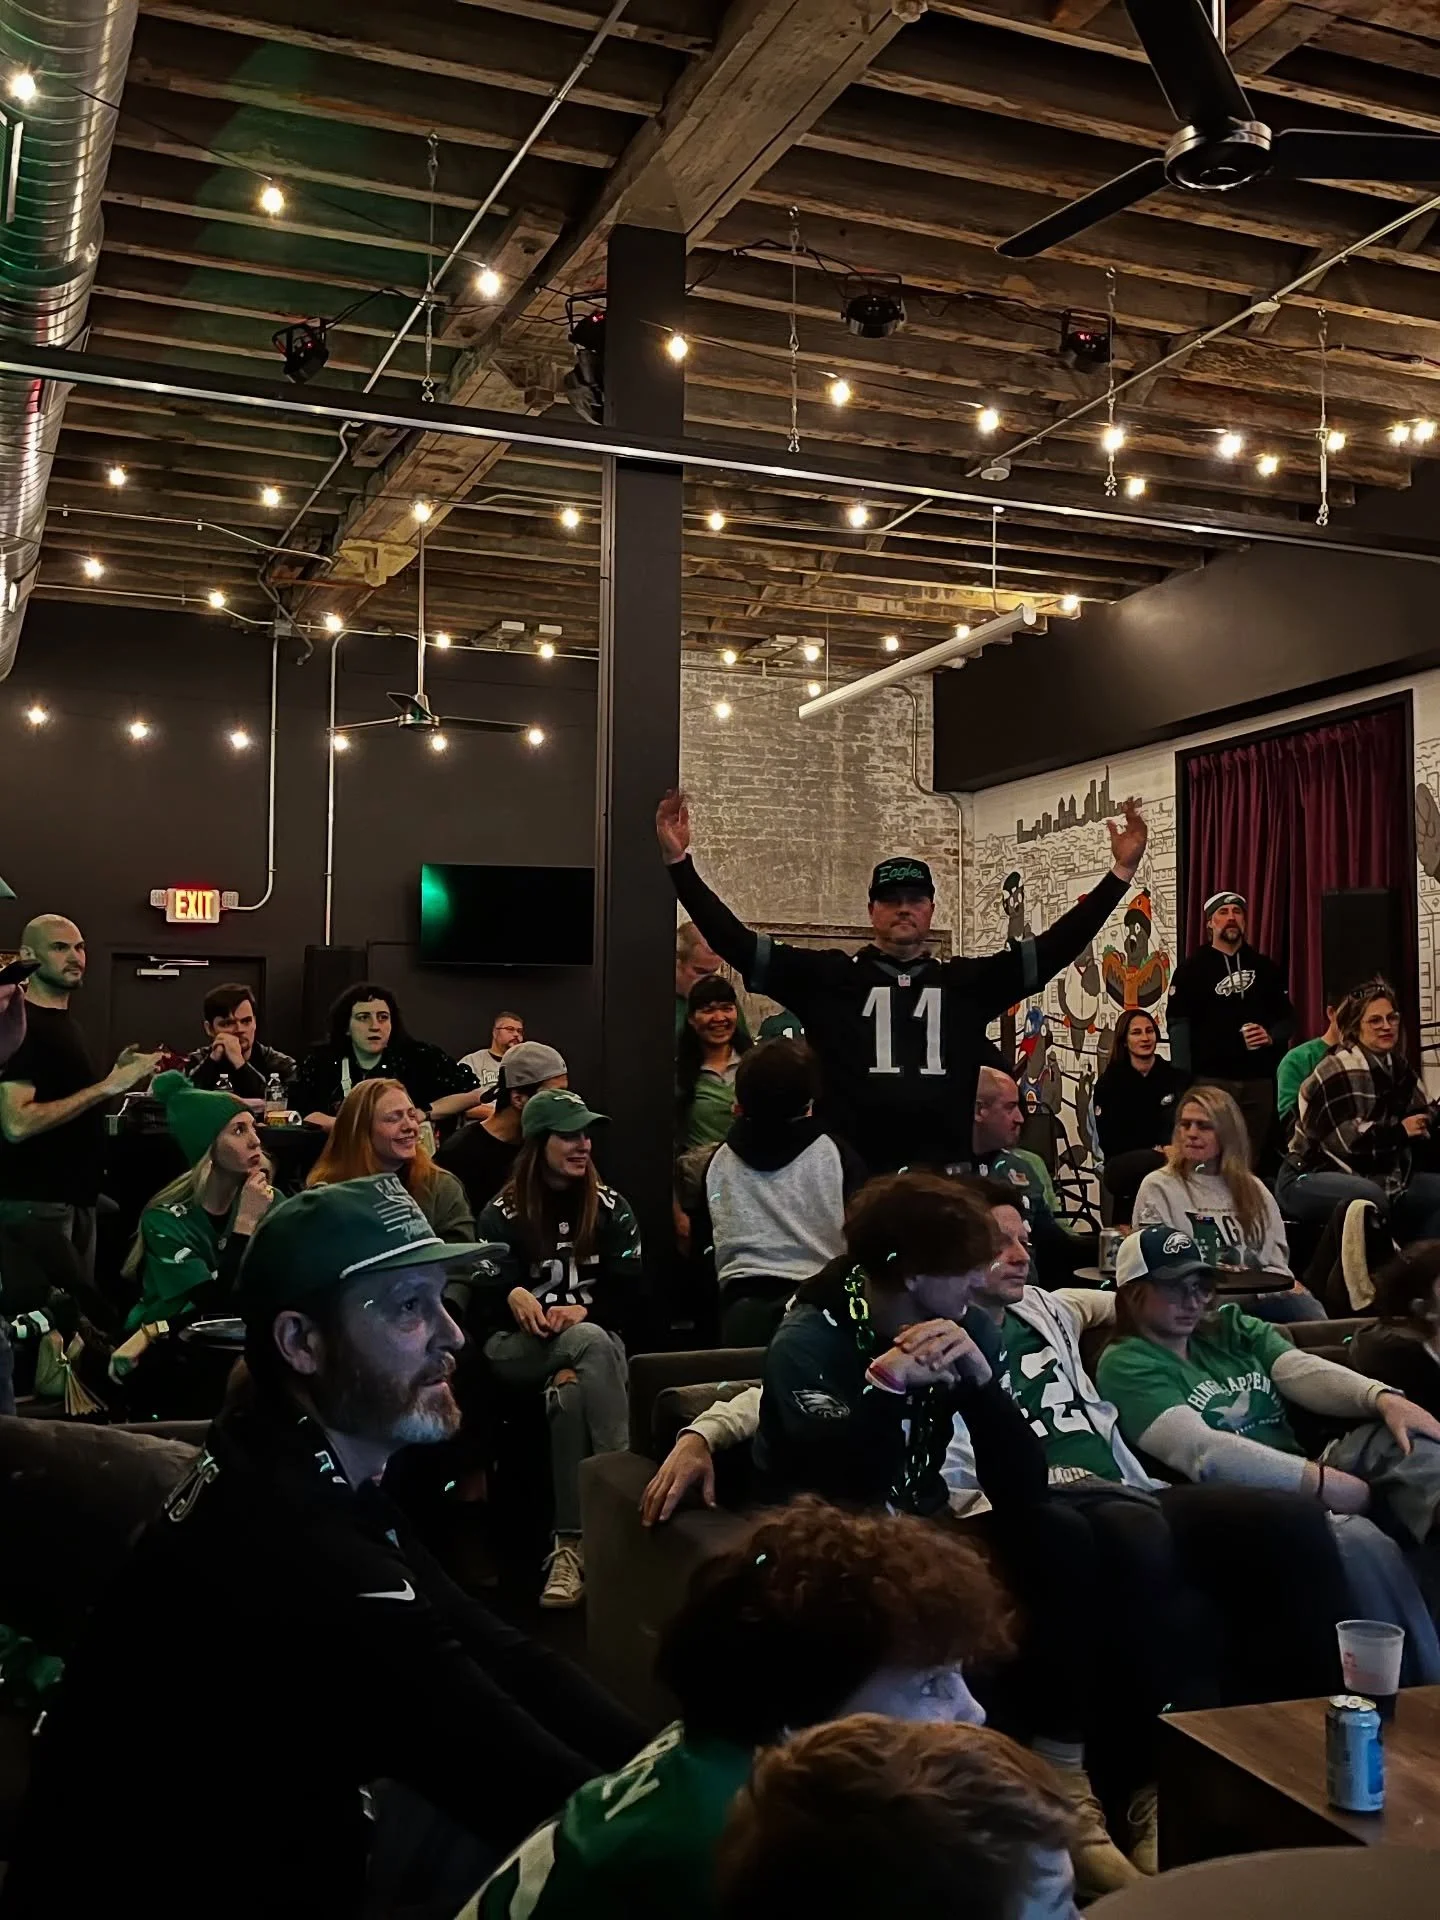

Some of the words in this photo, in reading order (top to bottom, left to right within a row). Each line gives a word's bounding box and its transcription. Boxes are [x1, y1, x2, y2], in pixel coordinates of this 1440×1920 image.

[879, 863, 924, 883] Eagles
[175, 889, 214, 920] EXIT
[861, 986, 947, 1075] 11
